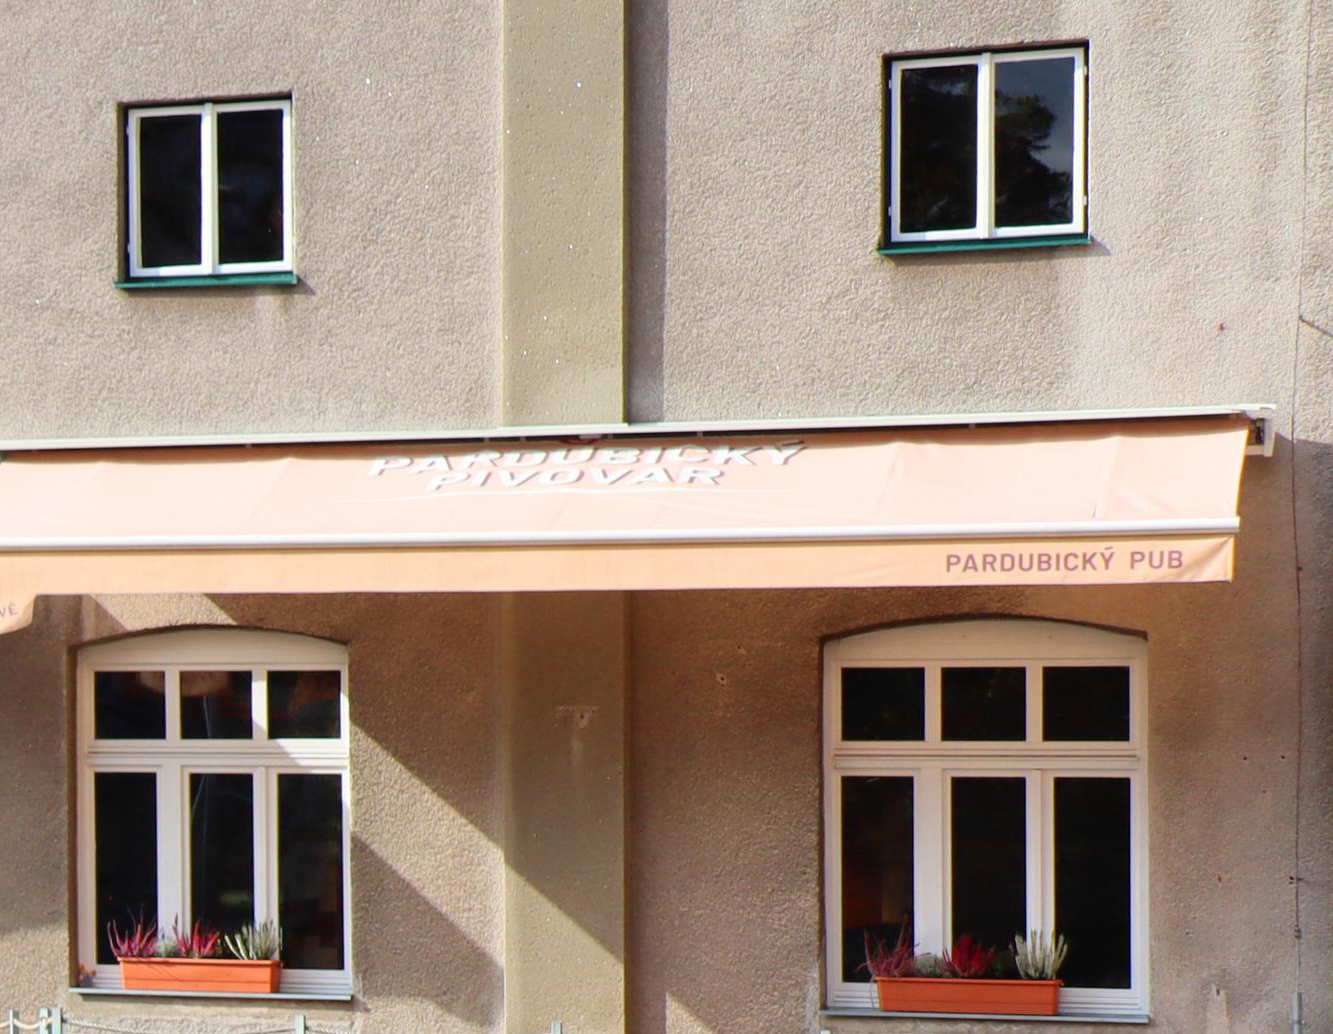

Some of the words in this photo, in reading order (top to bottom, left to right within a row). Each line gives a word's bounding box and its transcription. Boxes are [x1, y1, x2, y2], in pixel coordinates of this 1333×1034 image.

[367, 440, 808, 477] PARDUBICKÝ
[427, 466, 727, 492] PIVOVAR
[945, 546, 1115, 573] PARDUBICKÝ
[1129, 550, 1184, 571] PUB
